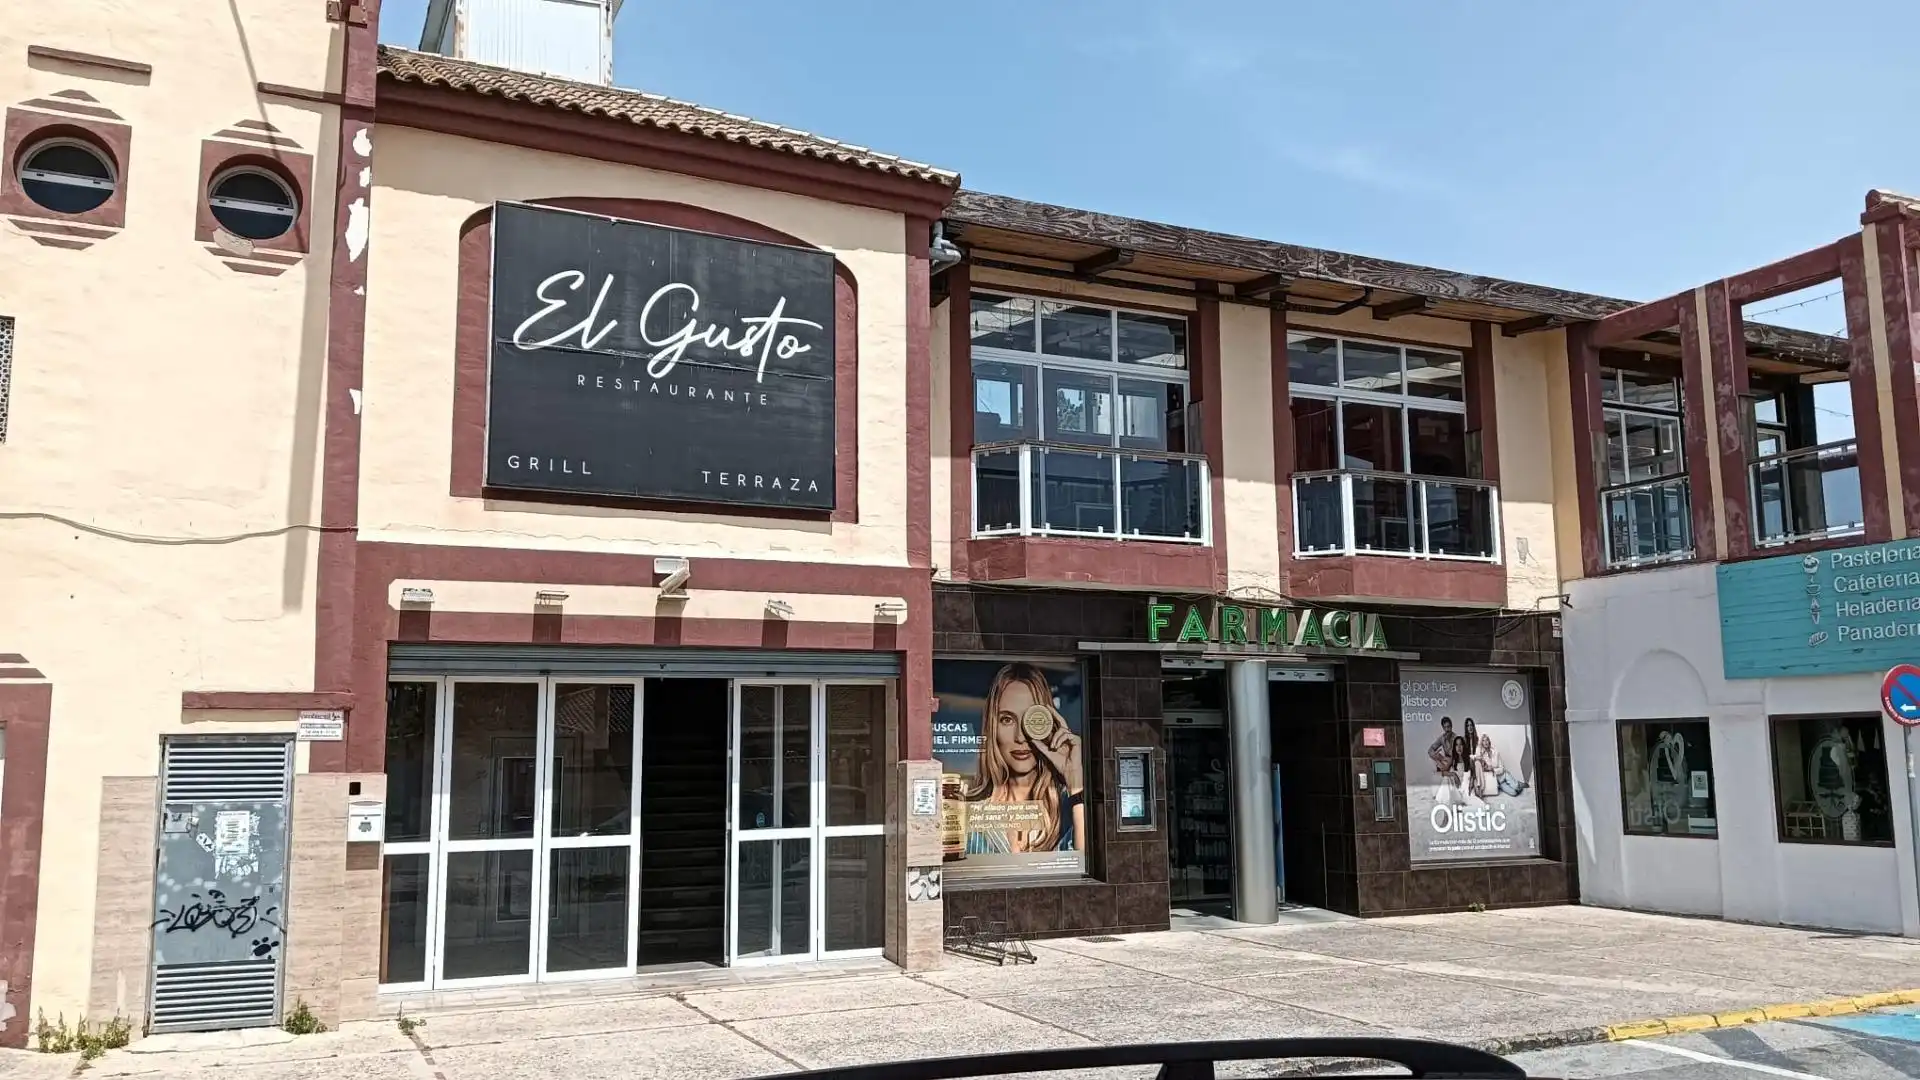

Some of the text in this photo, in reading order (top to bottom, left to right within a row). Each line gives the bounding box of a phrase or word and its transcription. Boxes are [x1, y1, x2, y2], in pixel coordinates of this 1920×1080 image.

[513, 269, 823, 384] El Gusto
[577, 374, 768, 405] RESTAURANTE
[507, 455, 592, 475] GRILL
[701, 470, 819, 493] TERRAZA
[1147, 602, 1389, 650] FARMACIA
[1401, 680, 1411, 691] ol
[1402, 709, 1432, 722] entro
[932, 723, 968, 732] USCAS
[951, 735, 987, 745] FIRME?
[1430, 803, 1506, 833] Olistic
